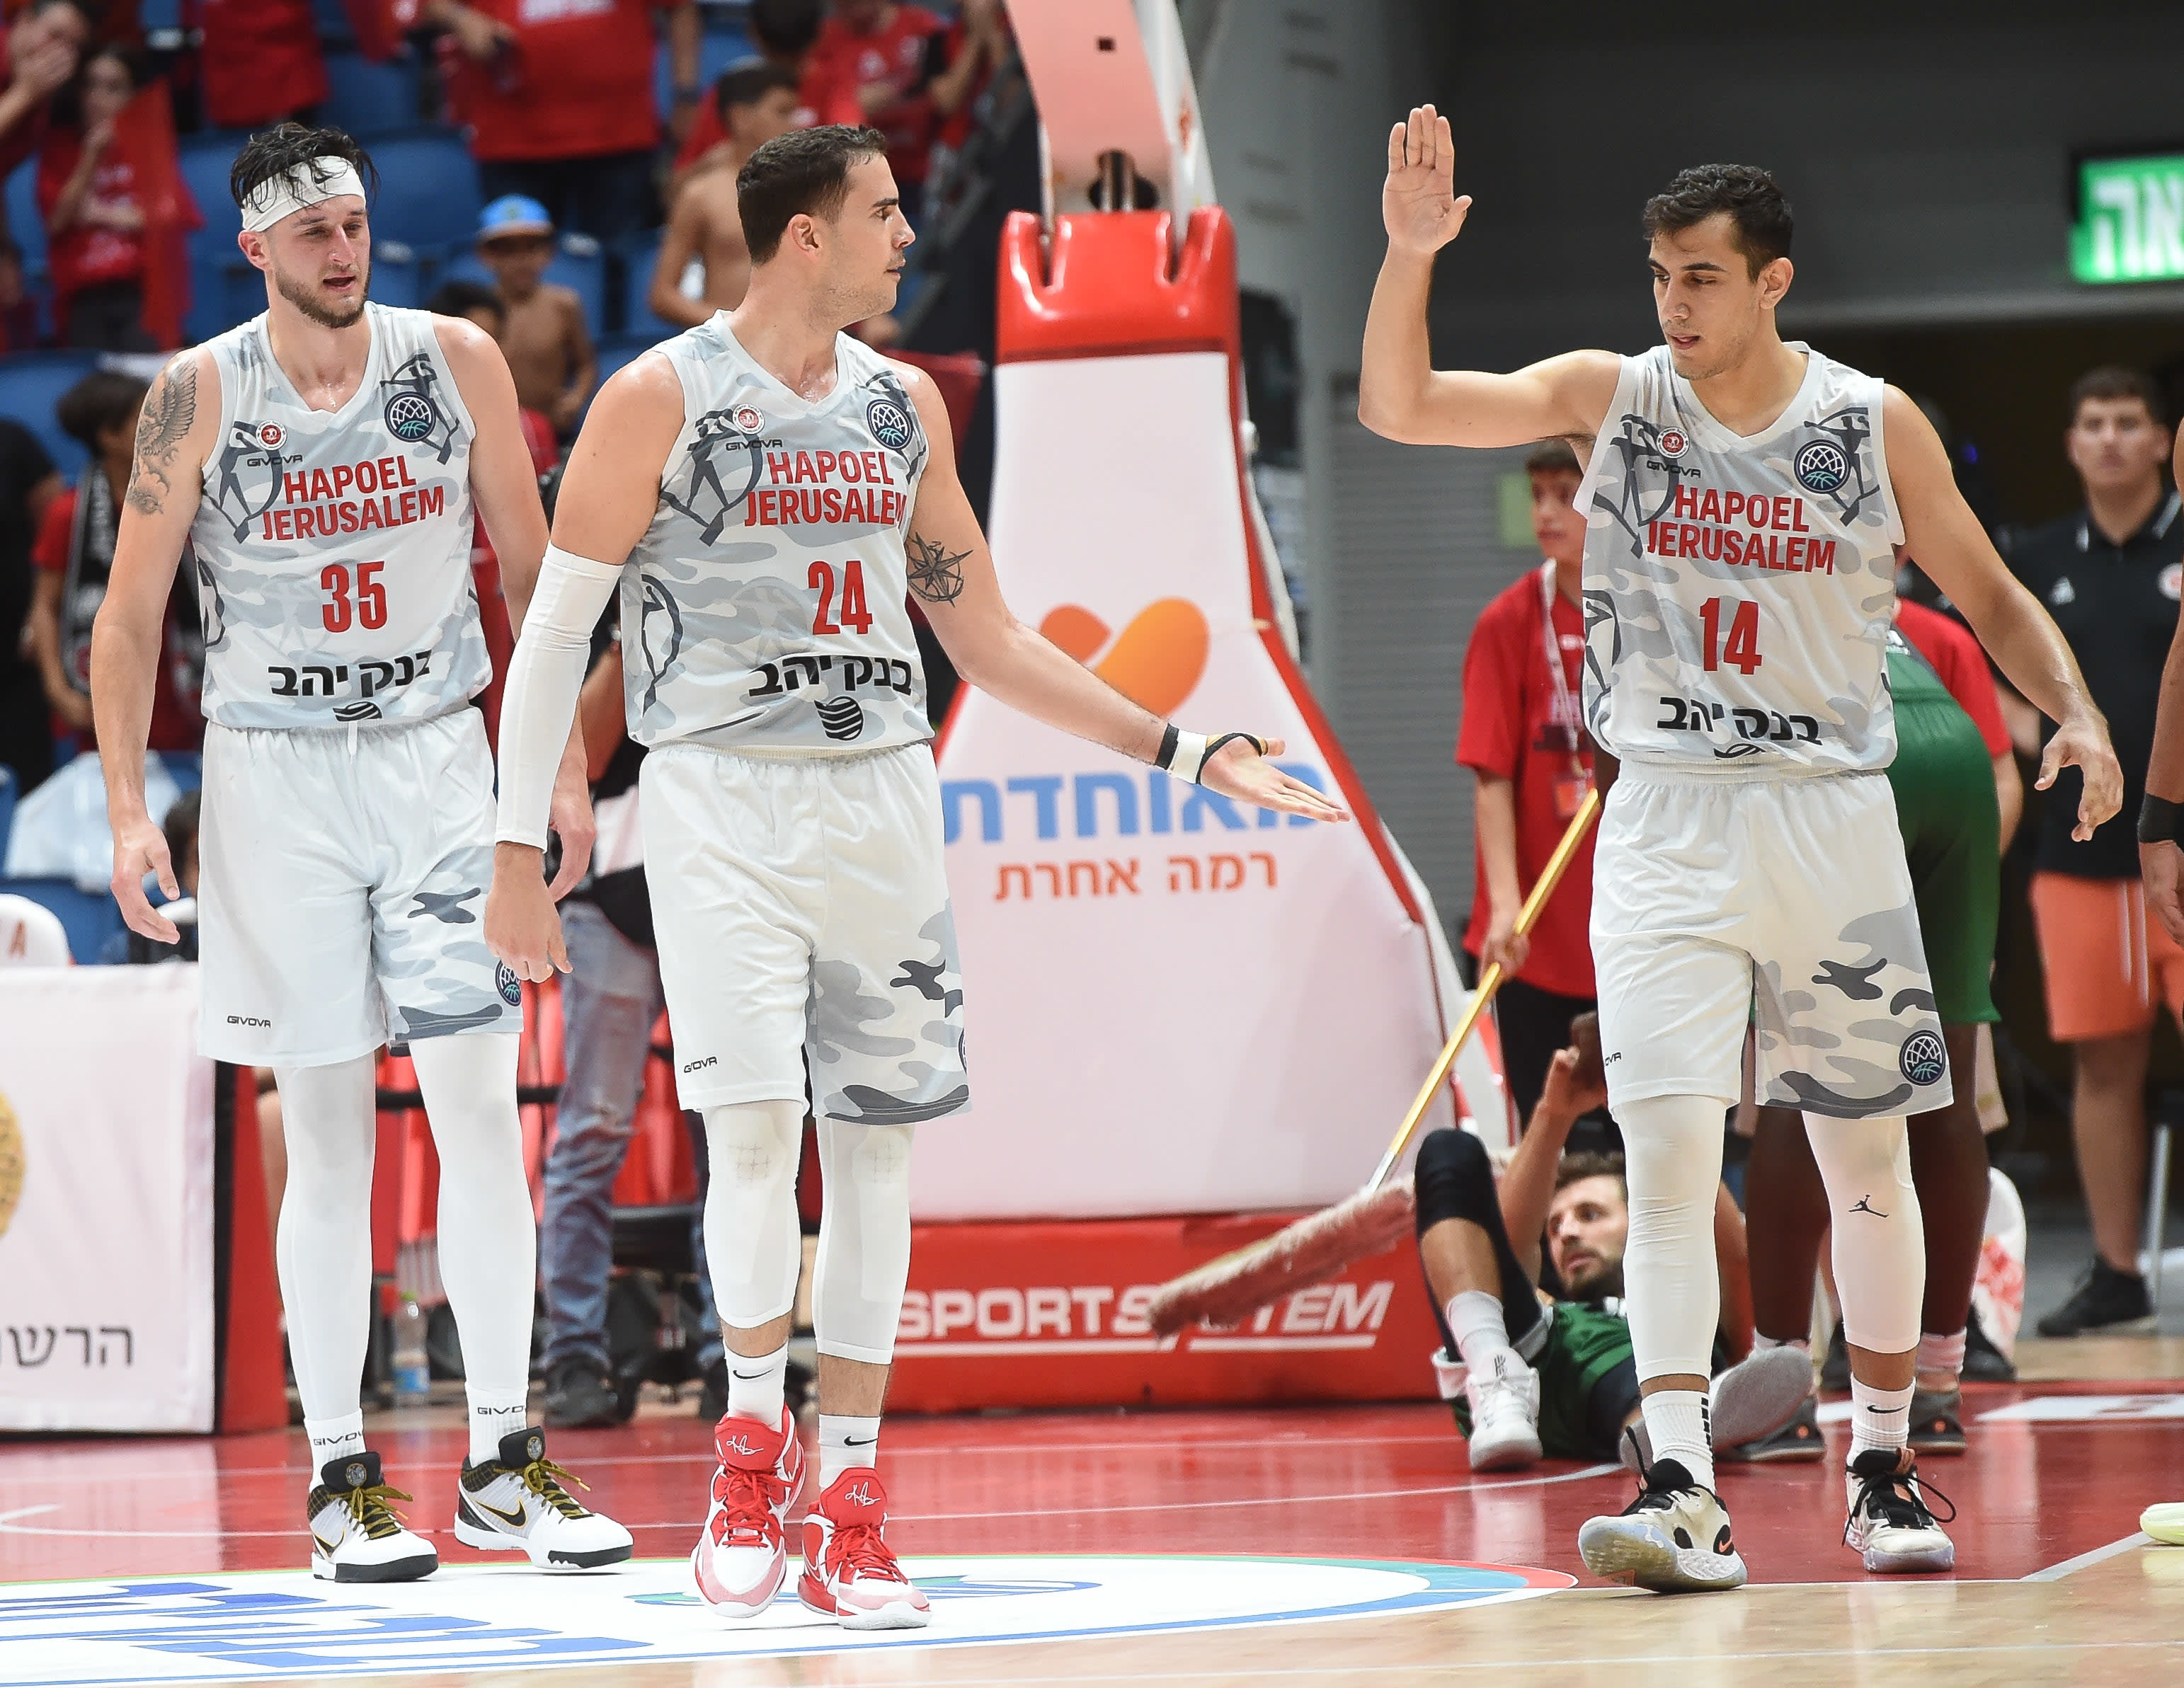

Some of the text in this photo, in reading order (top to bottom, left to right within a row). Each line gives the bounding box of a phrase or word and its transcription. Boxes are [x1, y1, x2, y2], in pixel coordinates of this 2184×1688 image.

[246, 454, 303, 467] GIVOVA
[726, 438, 783, 452] GIVOVA
[767, 450, 895, 486] HAPOEL
[1646, 460, 1701, 479] GIVOVA
[283, 454, 416, 505] HAPOEL
[262, 486, 445, 541] JERUSALEM
[1674, 484, 1809, 533] HAPOEL
[1647, 520, 1836, 575] JERUSALEM
[320, 560, 388, 633] 35
[808, 560, 873, 636] 24
[1699, 597, 1763, 675] 14
[268, 664, 349, 697] יהב
[748, 655, 913, 697] בנק יהב
[1657, 696, 1824, 746] בנק יהב
[995, 851, 1279, 902] רמה אחרת
[227, 1014, 272, 1029] GIVOVA
[896, 1281, 1395, 1338] SPORTSEM
[0, 1324, 133, 1366] הרש
